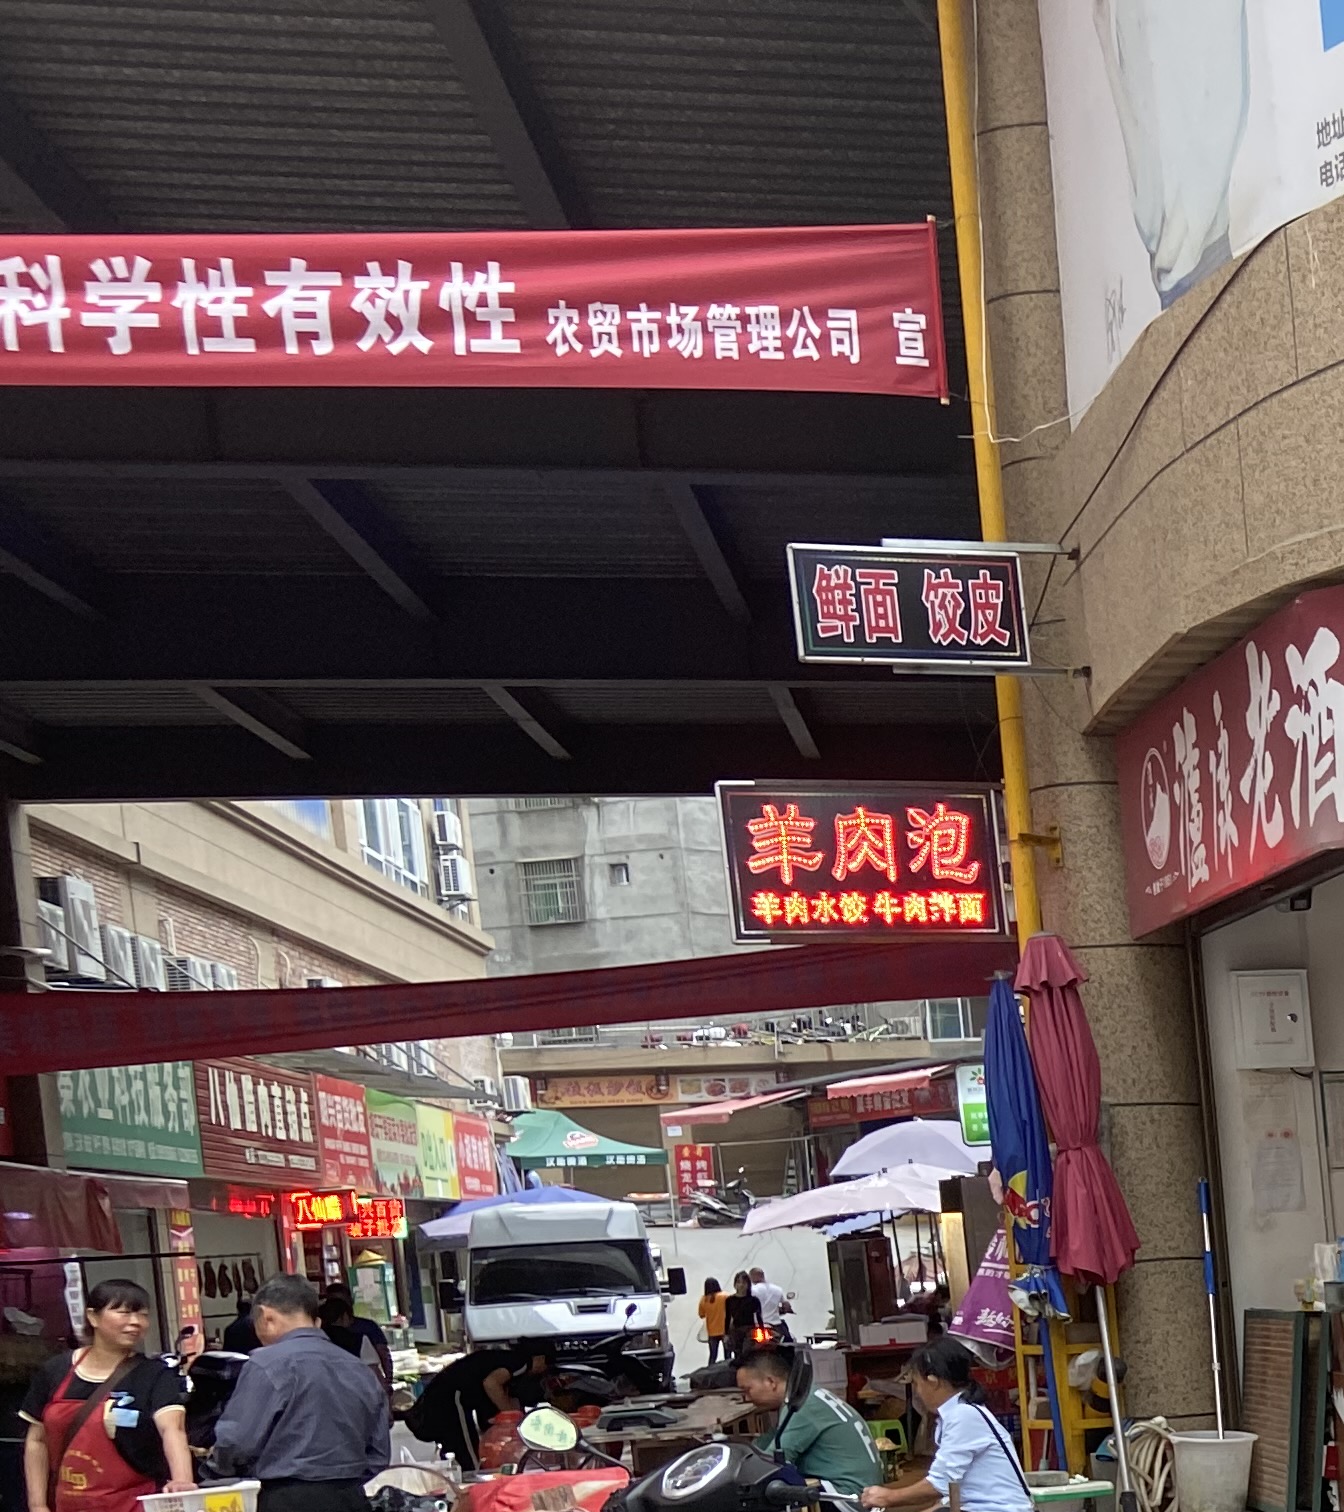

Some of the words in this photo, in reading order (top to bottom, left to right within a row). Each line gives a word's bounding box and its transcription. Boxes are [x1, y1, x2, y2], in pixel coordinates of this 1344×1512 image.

[0, 254, 523, 358] 科学性有效性
[547, 301, 862, 365] 农贸市场管理公司
[893, 308, 930, 368] 宣
[813, 564, 902, 643] 鲜面
[922, 568, 1010, 646] 饺皮
[747, 802, 982, 885] 羊肉泡
[751, 891, 869, 925] 羊肉水饺
